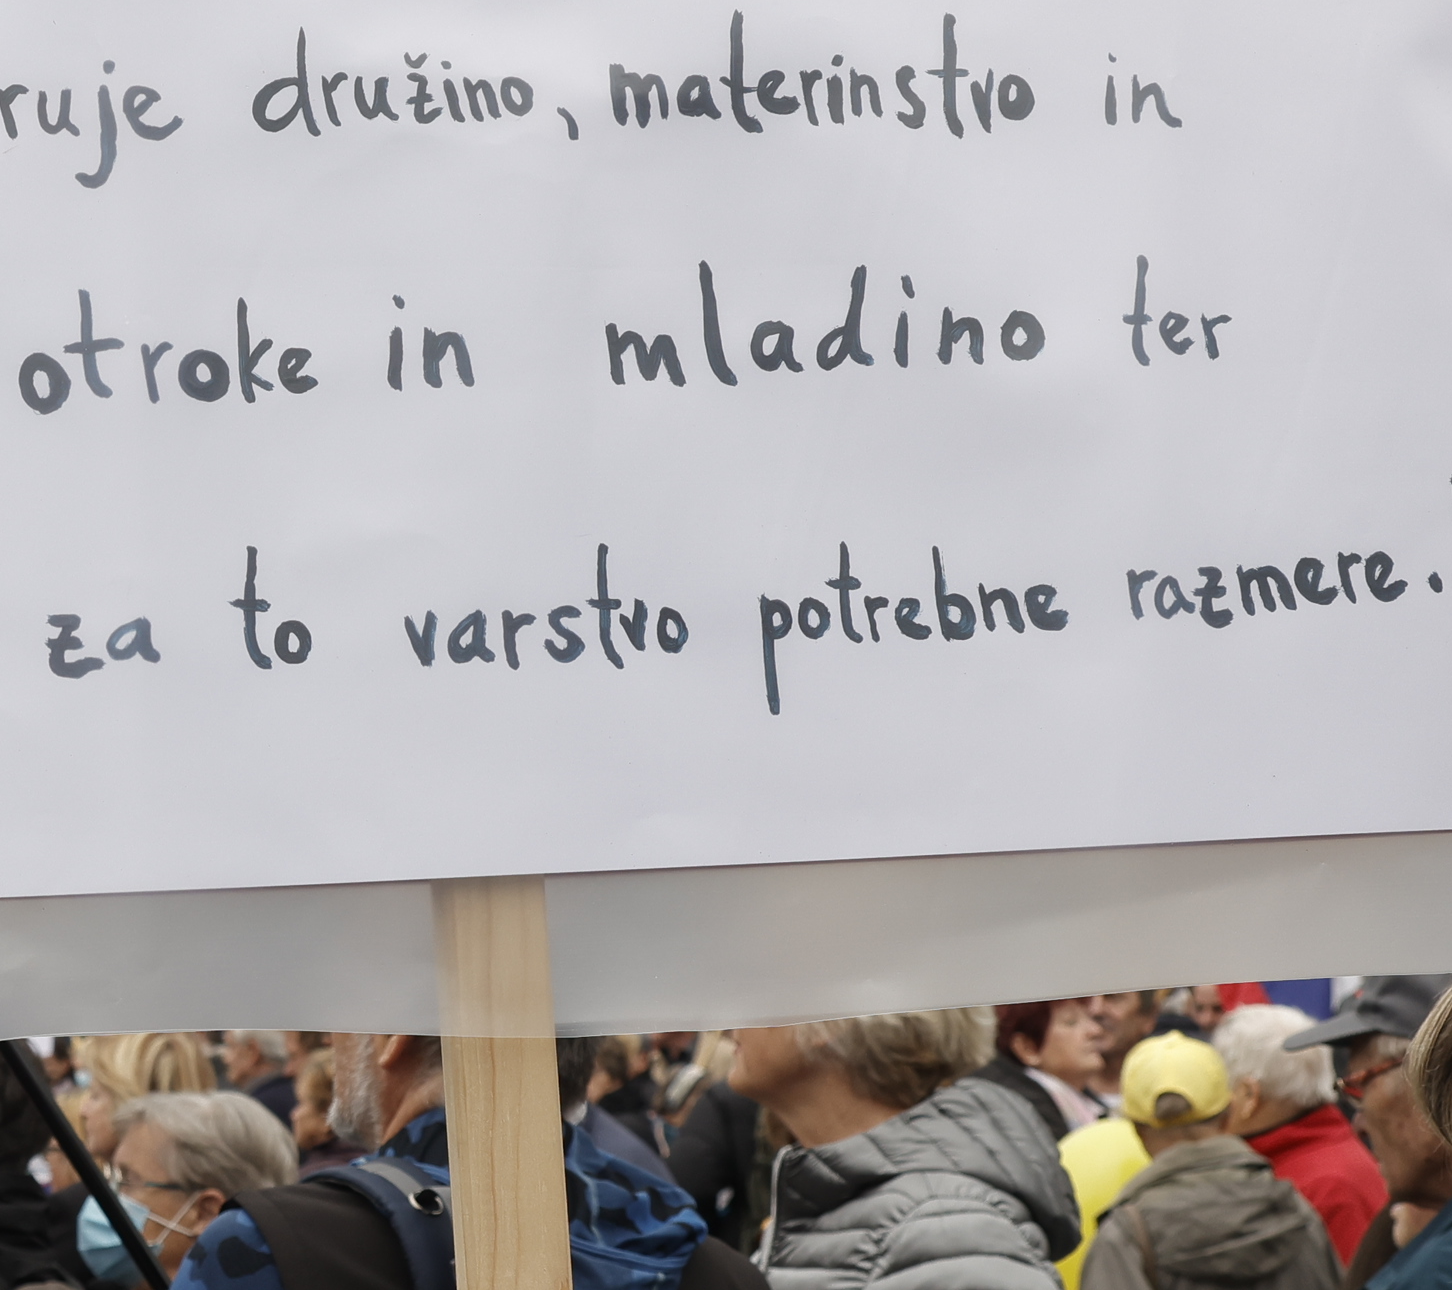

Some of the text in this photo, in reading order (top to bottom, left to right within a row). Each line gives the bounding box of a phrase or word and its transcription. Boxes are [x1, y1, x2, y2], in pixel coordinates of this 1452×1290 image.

[252, 27, 581, 141] družino,
[609, 10, 1038, 138] materinstvo
[1105, 55, 1184, 129] in
[18, 289, 320, 412] otroke
[386, 296, 476, 390] in
[606, 260, 1047, 387] mladino
[1122, 255, 1232, 367] ter
[46, 613, 162, 679] za
[230, 546, 314, 670] to
[404, 542, 690, 670] varstvo
[760, 541, 1070, 715] potrebne
